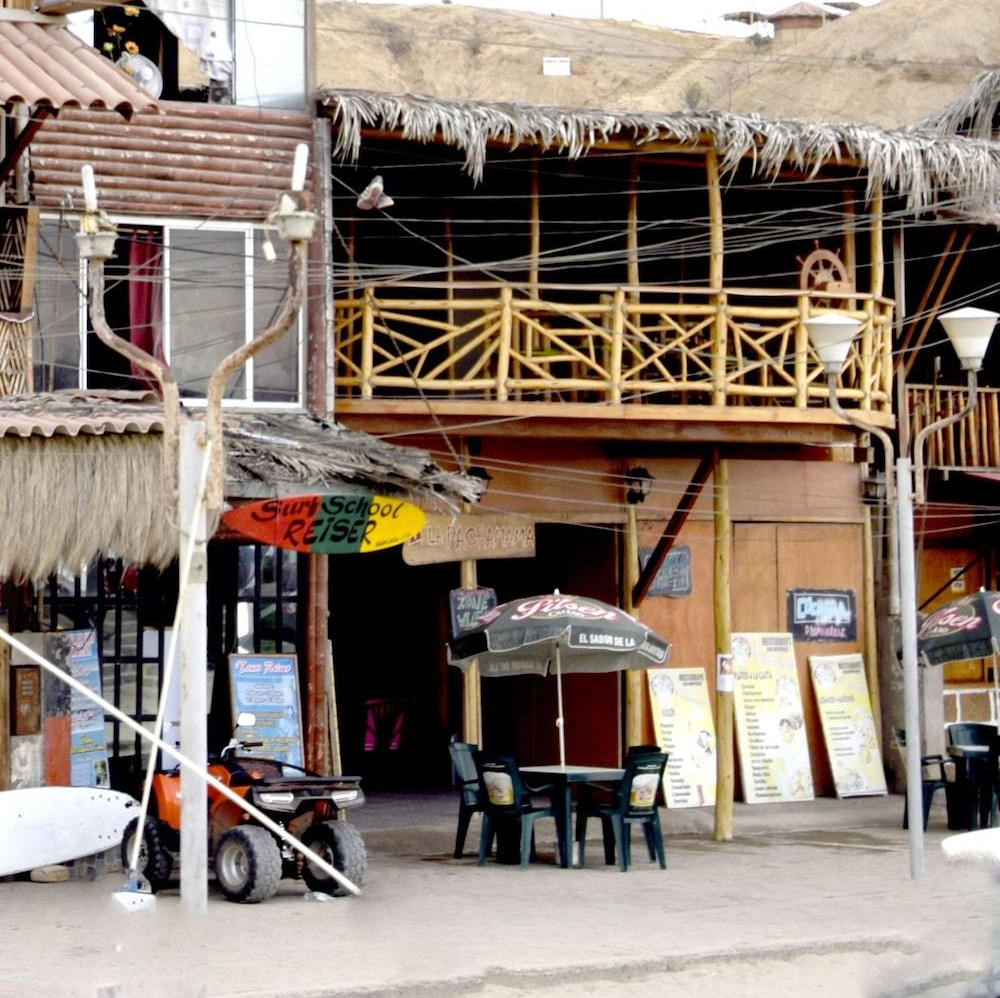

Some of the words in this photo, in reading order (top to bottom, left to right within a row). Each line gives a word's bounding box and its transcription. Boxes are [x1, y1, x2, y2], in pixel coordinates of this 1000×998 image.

[251, 496, 320, 521] Surf
[321, 495, 401, 519] School
[511, 597, 618, 621] Pilsen
[579, 633, 588, 644] EL
[590, 633, 613, 646] SABOR
[614, 636, 625, 647] DE
[625, 637, 636, 647] LA
